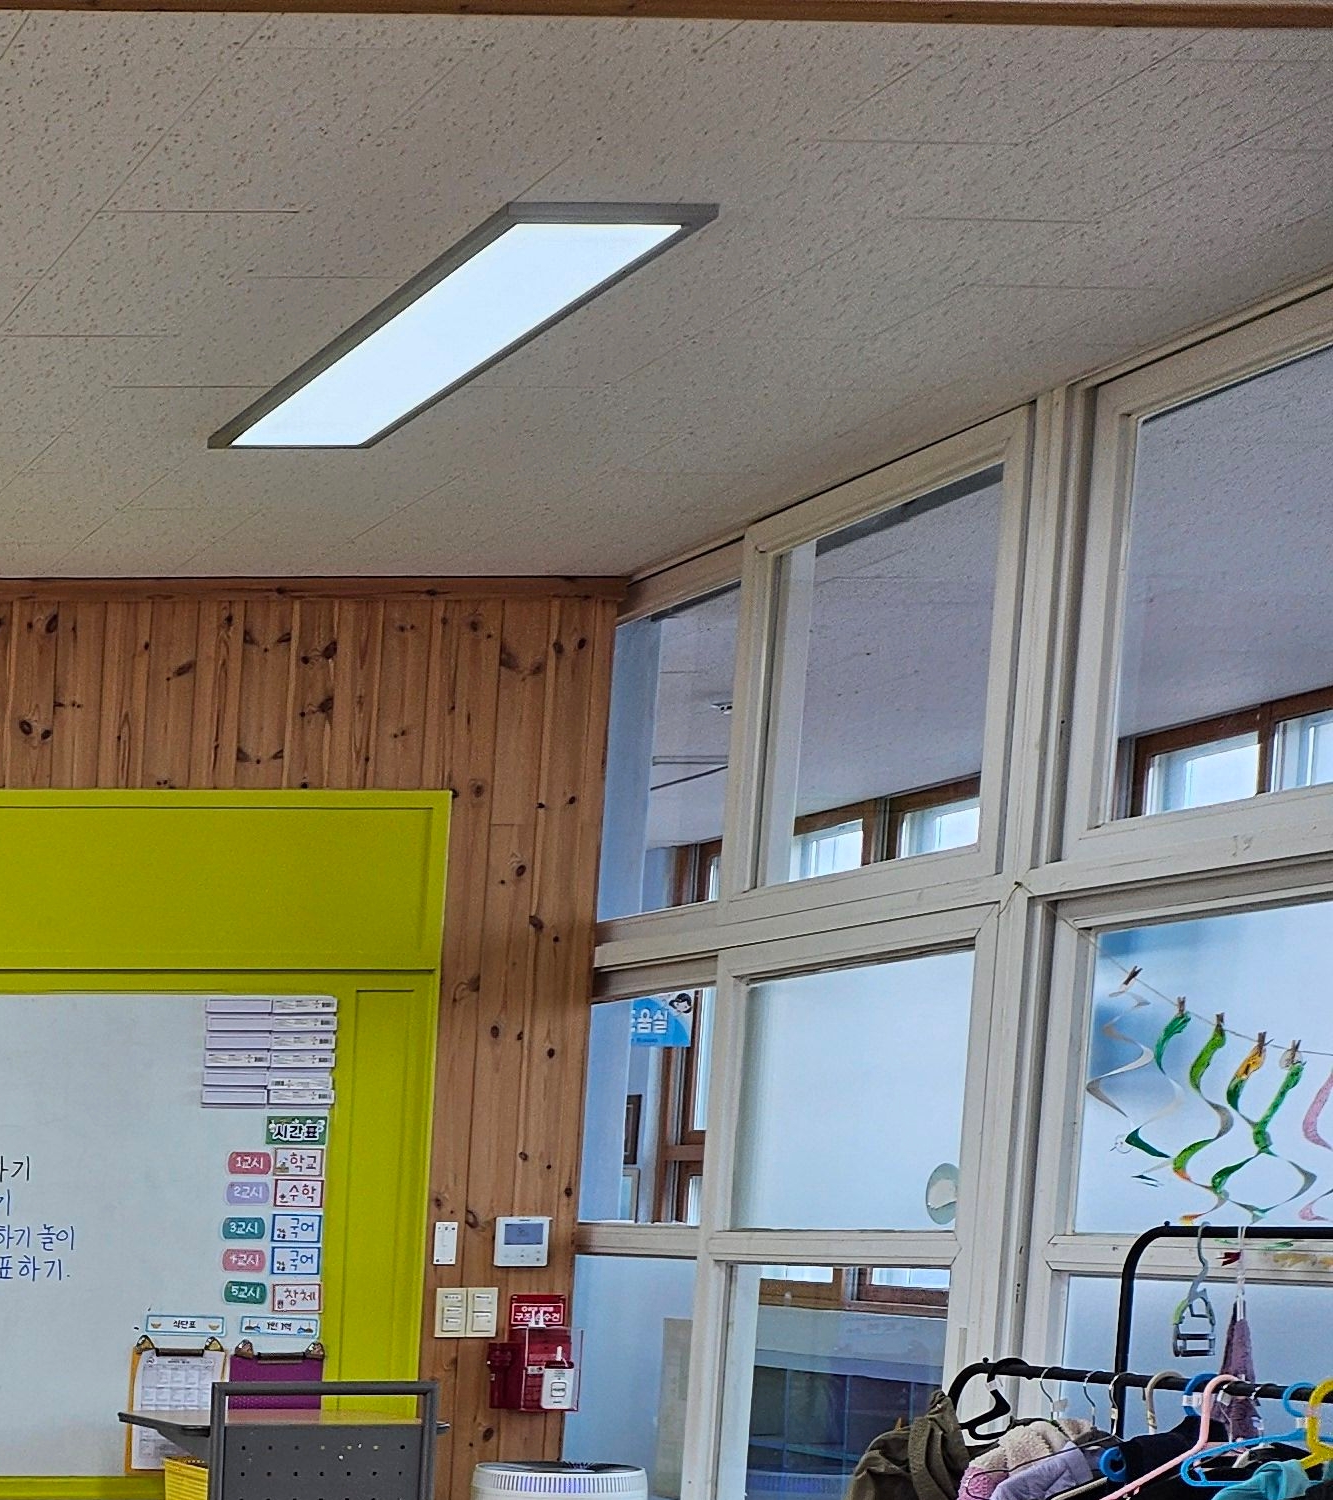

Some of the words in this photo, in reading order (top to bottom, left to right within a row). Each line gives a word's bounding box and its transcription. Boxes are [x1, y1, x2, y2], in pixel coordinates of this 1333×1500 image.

[631, 1009, 668, 1034] 움실
[275, 1125, 318, 1138] 시간표
[236, 1157, 263, 1169] 1교시
[290, 1152, 316, 1172] 학교
[234, 1186, 263, 1198] 2교시
[289, 1184, 316, 1202] 수학
[230, 1222, 258, 1233] 3교시
[290, 1218, 314, 1238] 국어
[37, 1223, 75, 1251] 놀이
[289, 1250, 313, 1271] 국어
[231, 1287, 259, 1298] 5교시
[283, 1287, 315, 1307] 창체
[173, 1320, 196, 1329] 식단표
